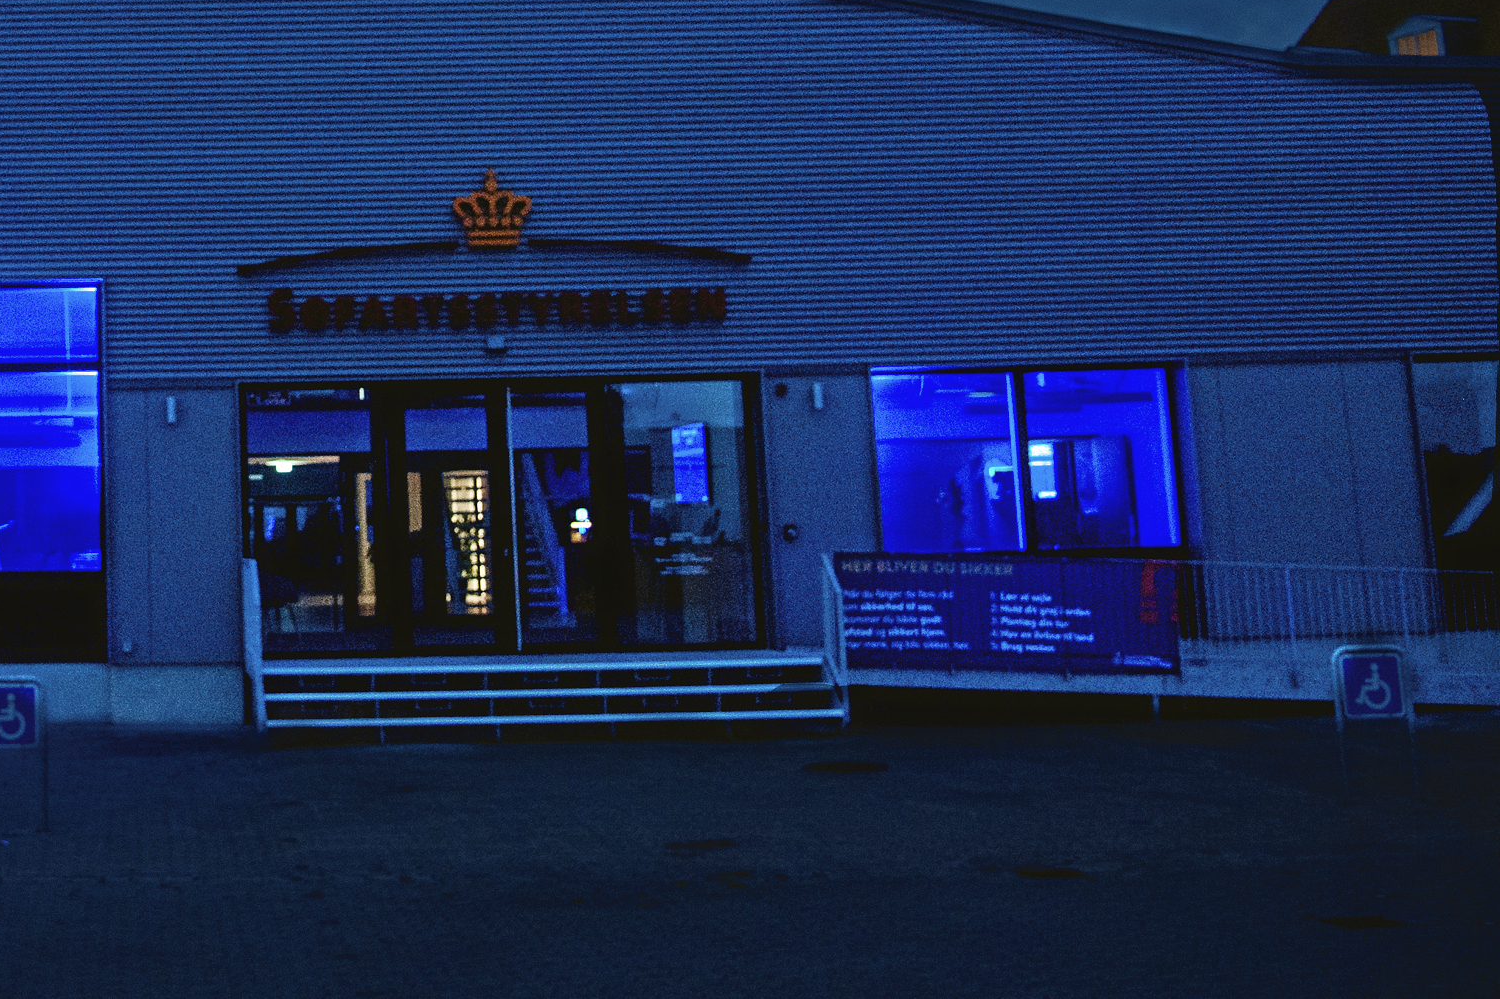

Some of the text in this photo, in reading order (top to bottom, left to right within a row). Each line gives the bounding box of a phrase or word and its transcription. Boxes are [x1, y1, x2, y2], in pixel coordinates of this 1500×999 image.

[841, 560, 1014, 575] HER BLIVER DU SIKKER
